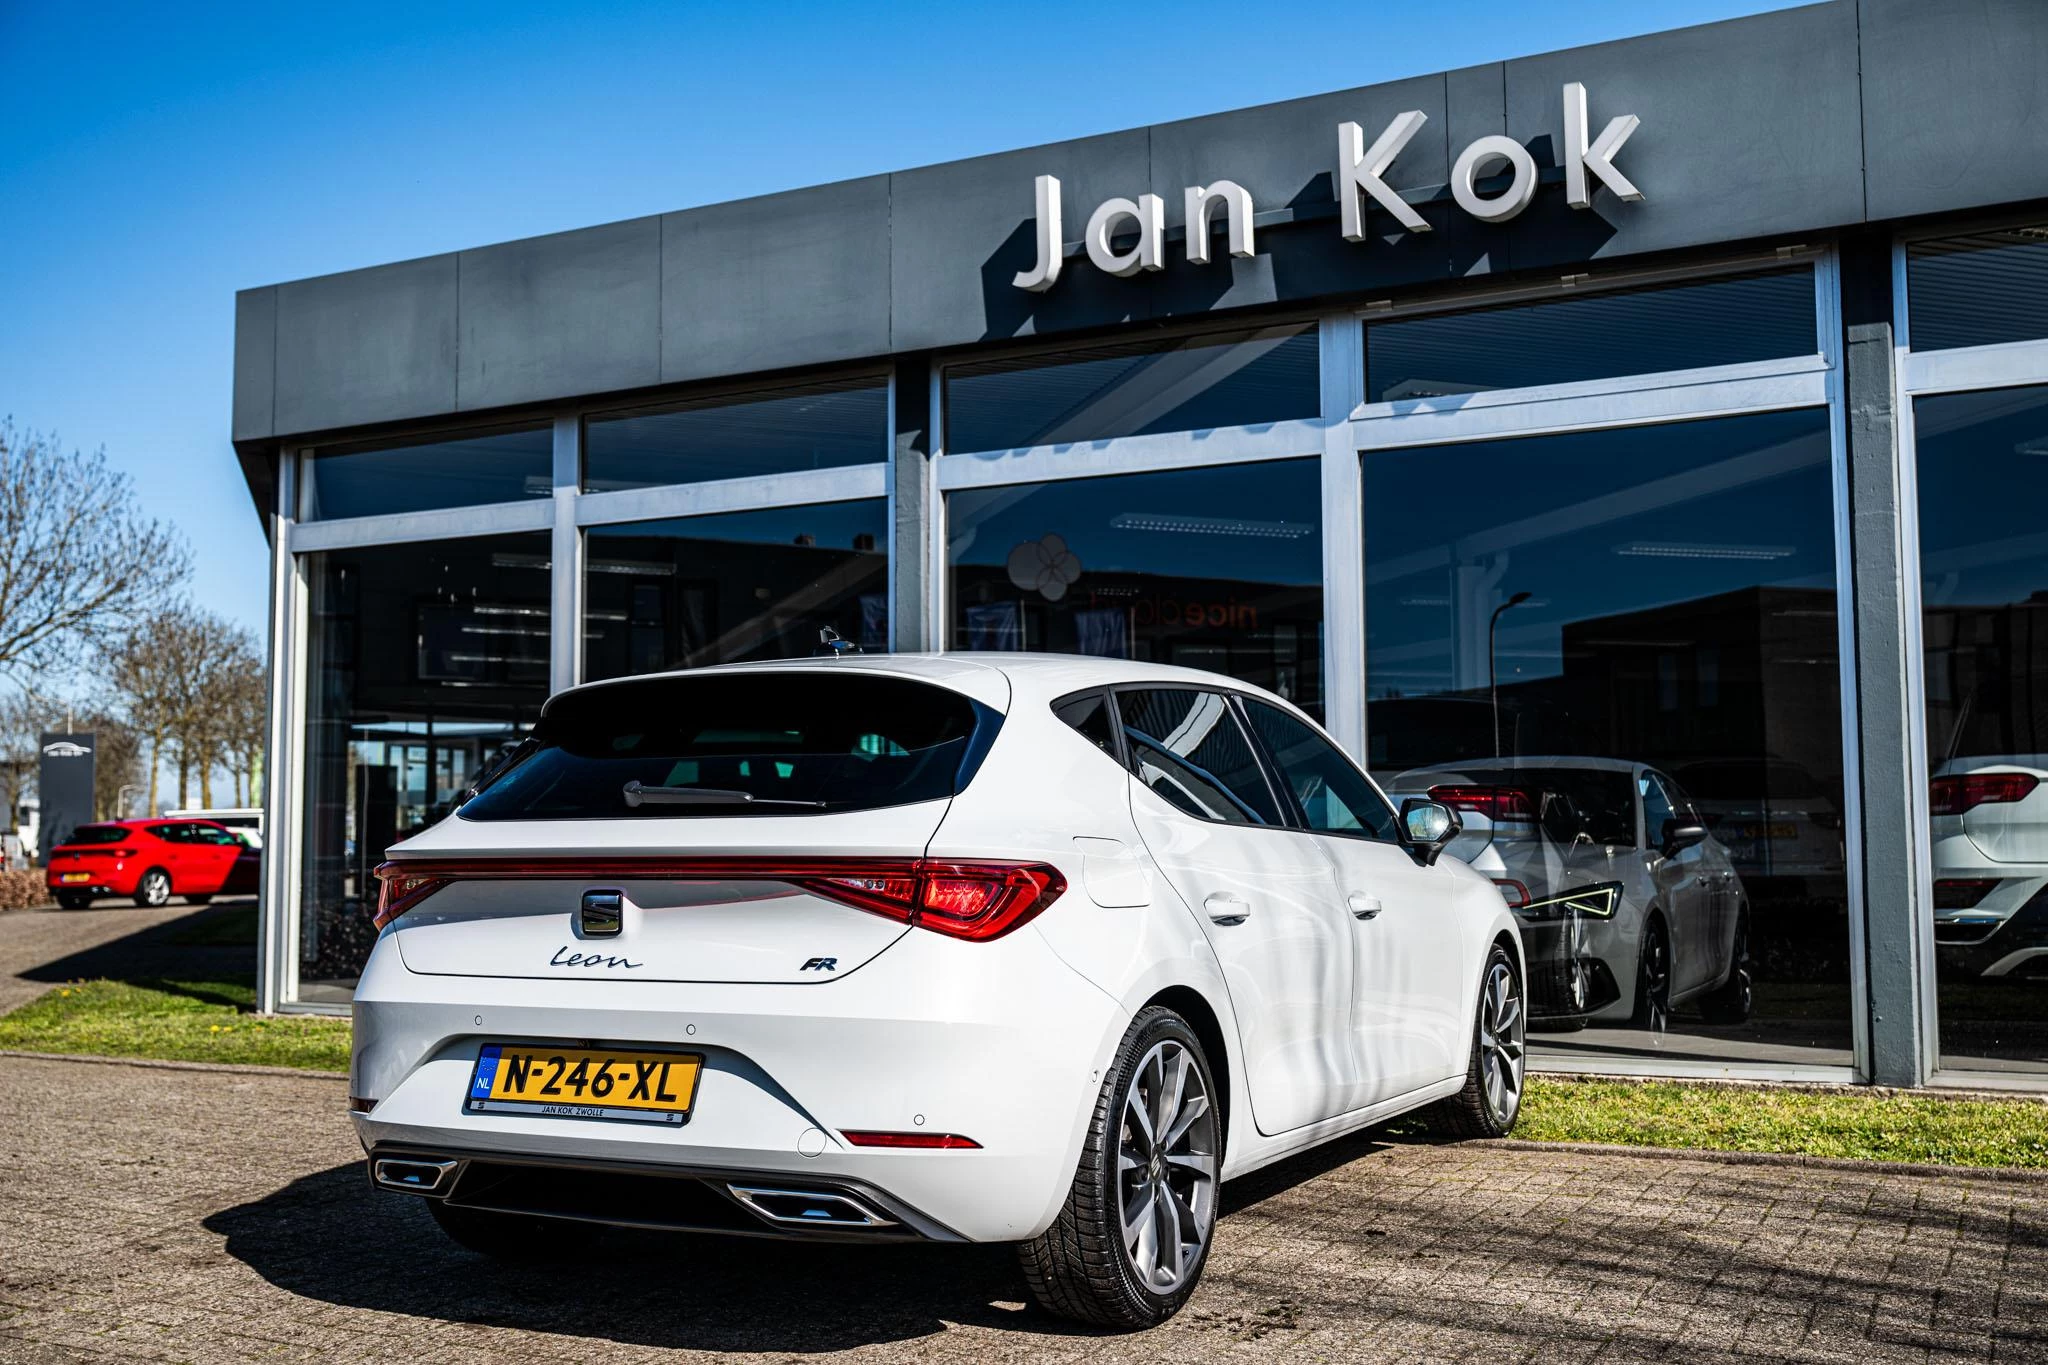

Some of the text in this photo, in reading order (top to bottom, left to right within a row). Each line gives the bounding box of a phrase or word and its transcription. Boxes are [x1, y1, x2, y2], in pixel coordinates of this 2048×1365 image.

[1012, 81, 1646, 293] Jan Kok
[550, 945, 643, 969] Leon
[799, 957, 838, 971] FR
[476, 1077, 490, 1089] NL
[503, 1054, 677, 1102] N-246-XL
[557, 1106, 573, 1115] KOK
[575, 1107, 604, 1117] ZWOLLE
